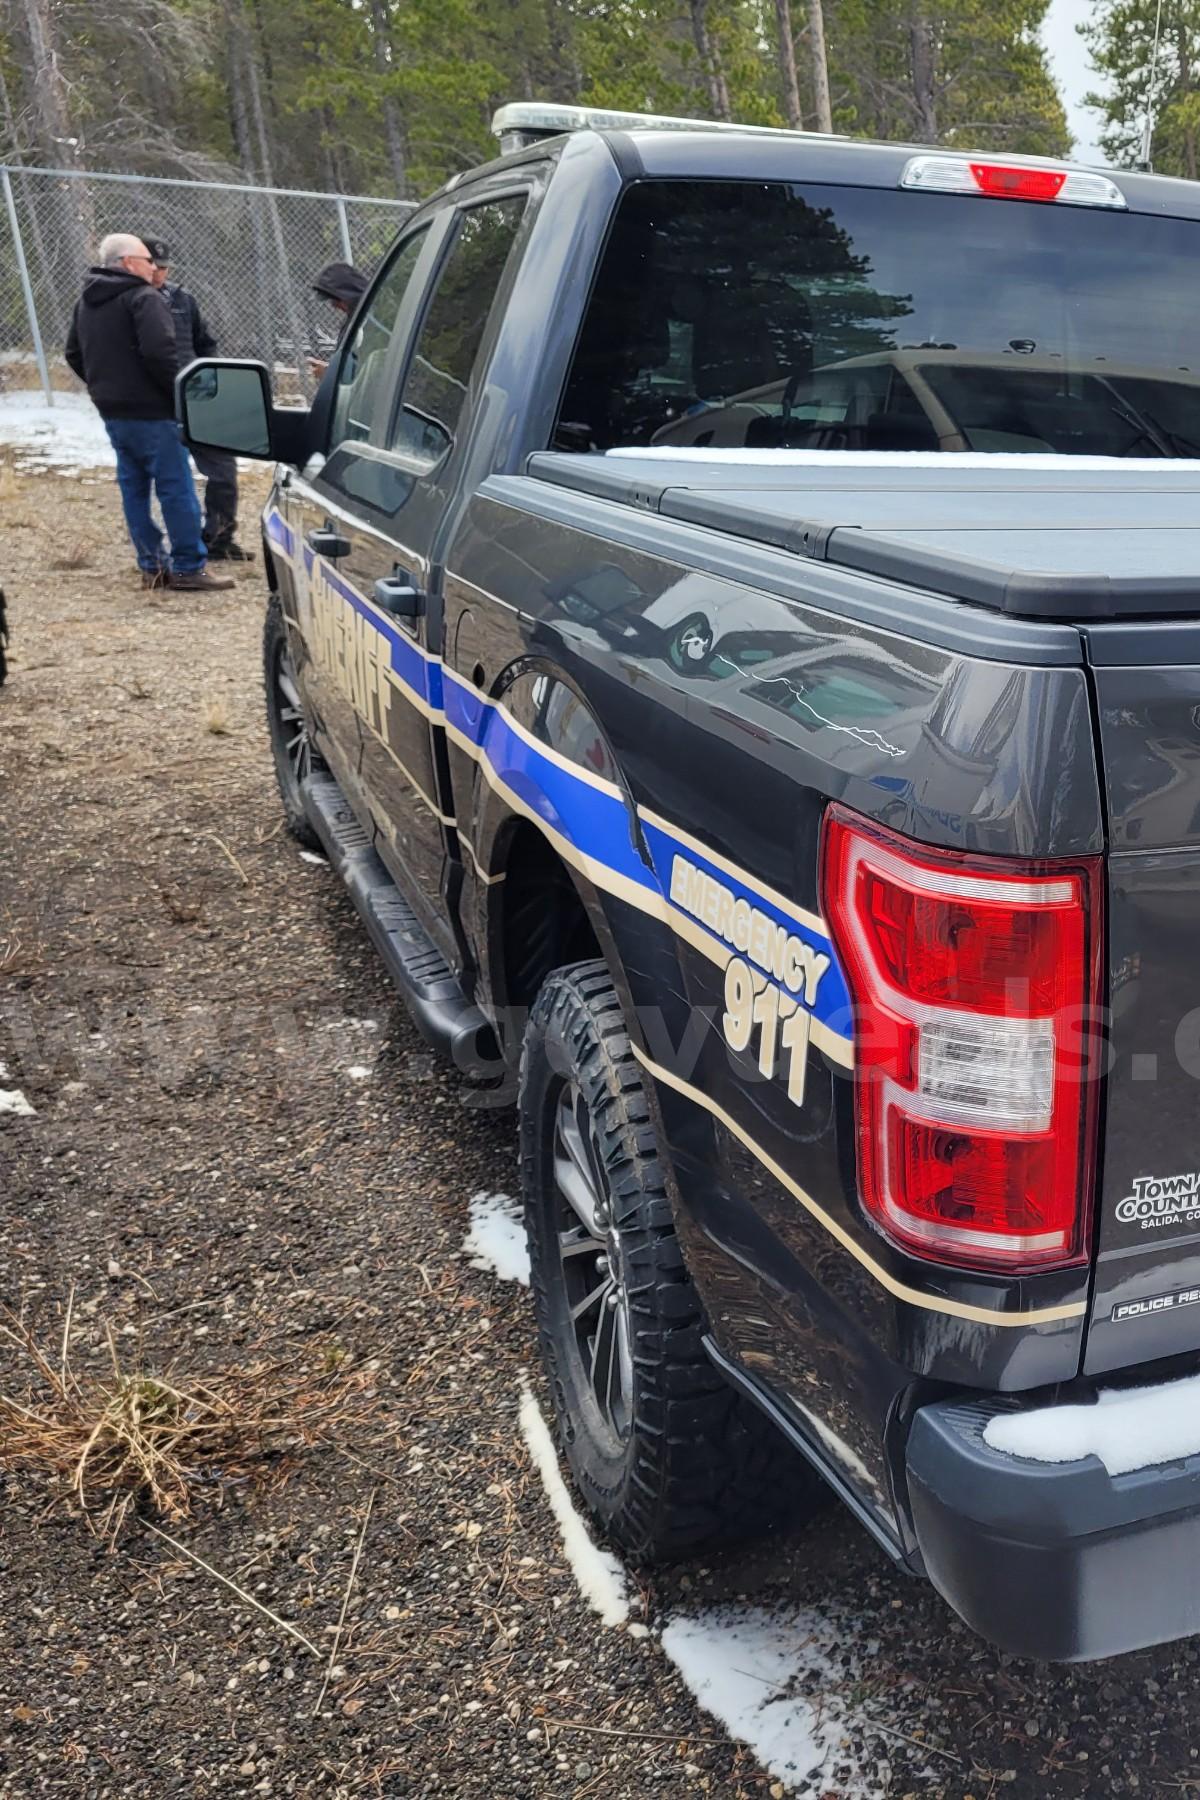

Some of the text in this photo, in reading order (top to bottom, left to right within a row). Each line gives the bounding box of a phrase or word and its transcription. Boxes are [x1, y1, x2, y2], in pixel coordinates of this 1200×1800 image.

[669, 853, 832, 1007] EMERGENCY
[722, 955, 813, 1107] 911
[1133, 1173, 1196, 1200] TOWN
[1141, 1217, 1183, 1229] SALIDA,
[1117, 1296, 1174, 1318] POLICE
